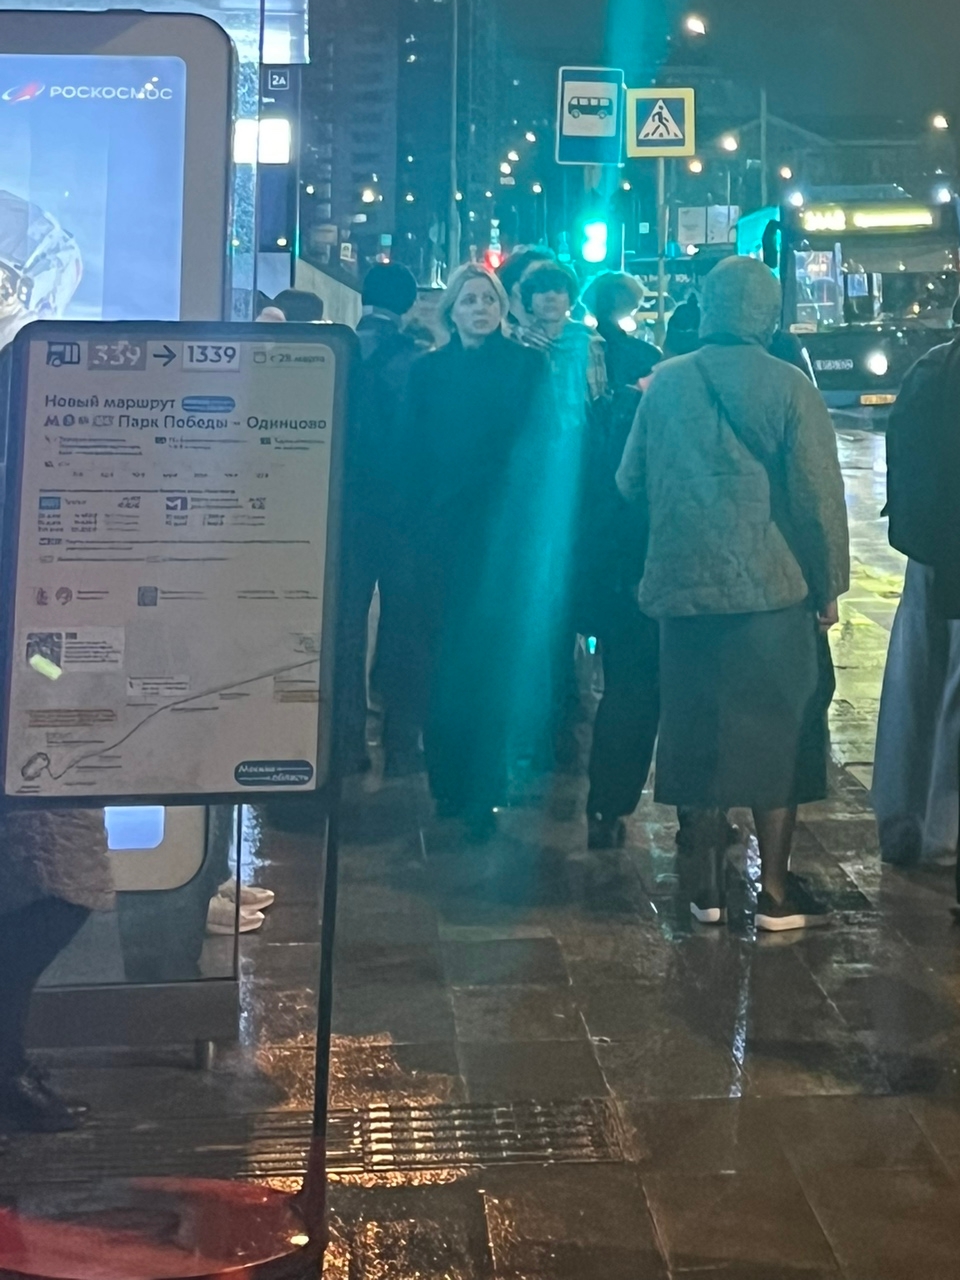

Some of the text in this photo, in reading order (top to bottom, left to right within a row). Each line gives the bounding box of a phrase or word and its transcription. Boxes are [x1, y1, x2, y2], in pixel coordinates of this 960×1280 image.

[49, 86, 173, 100] РОСКОСМОС
[187, 345, 237, 364] 1339
[45, 395, 99, 408] Новый
[104, 399, 175, 412] маршрут
[118, 414, 159, 430] Парк
[164, 415, 228, 430] Победы
[247, 416, 327, 430] Одинцово
